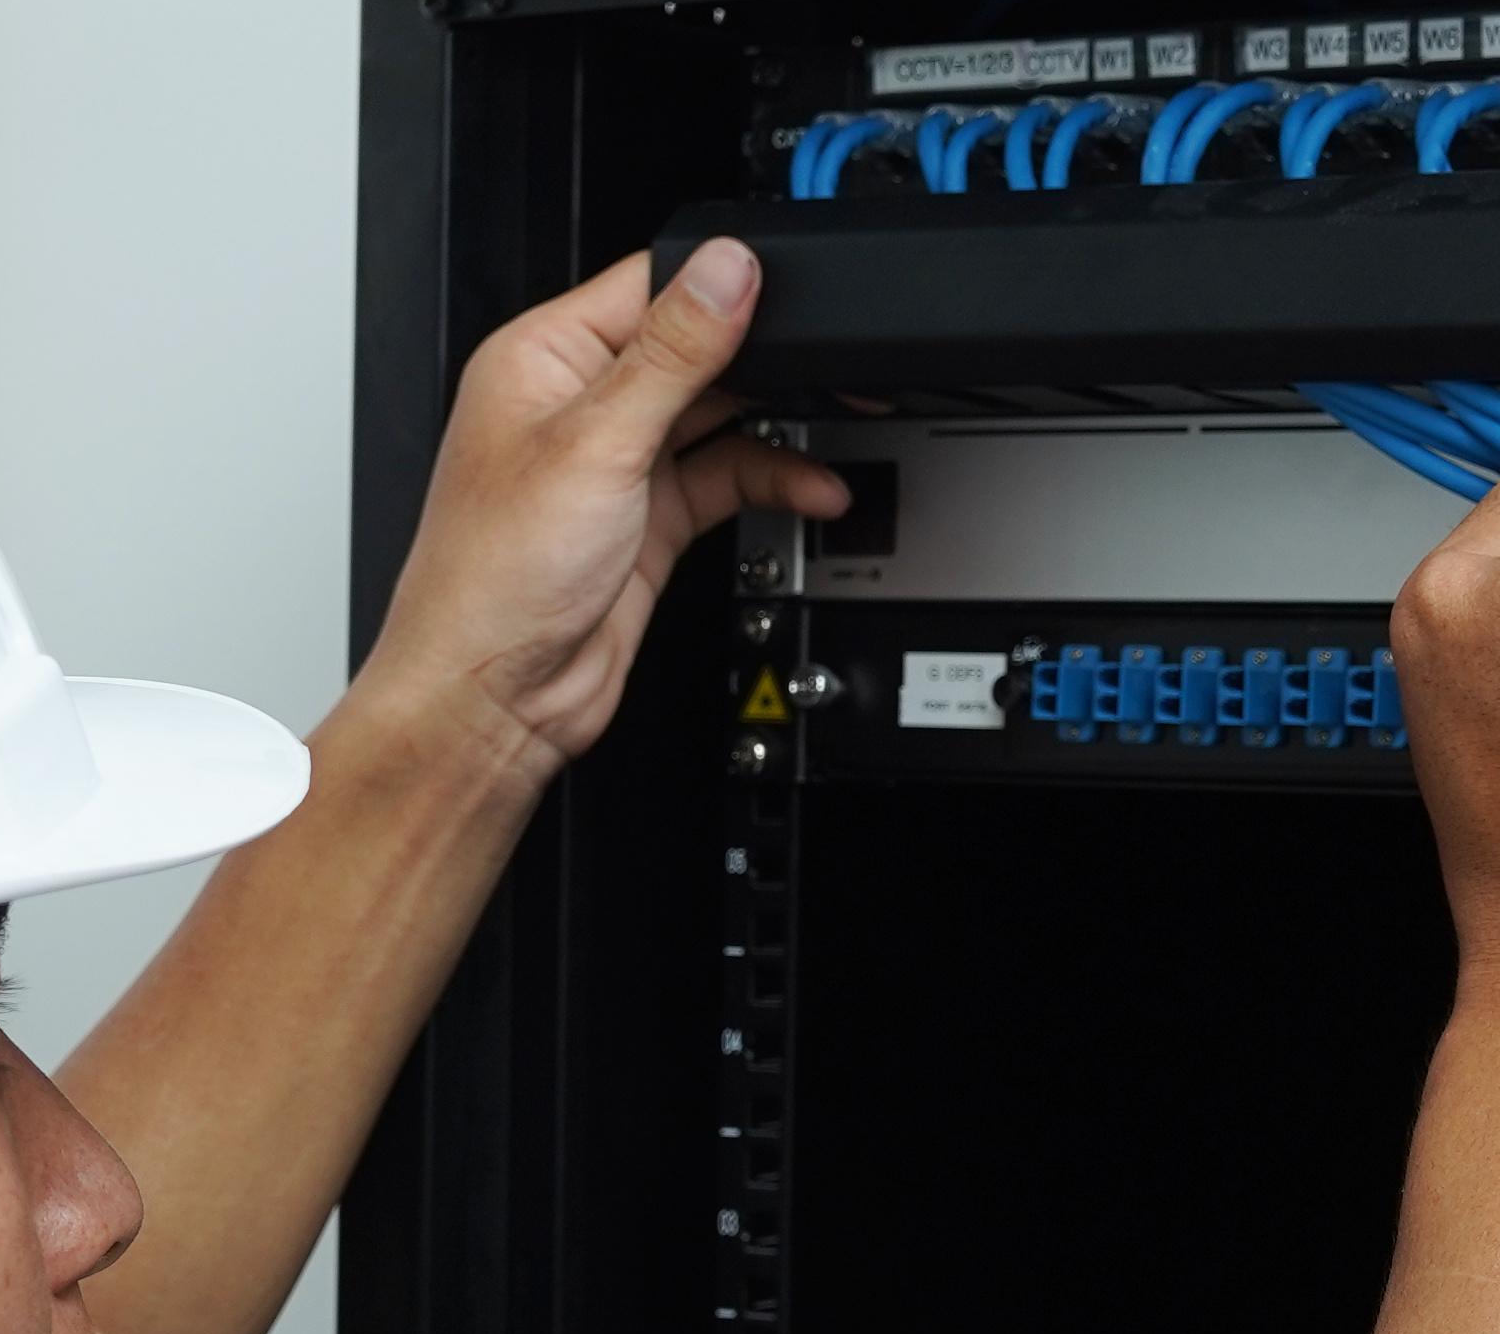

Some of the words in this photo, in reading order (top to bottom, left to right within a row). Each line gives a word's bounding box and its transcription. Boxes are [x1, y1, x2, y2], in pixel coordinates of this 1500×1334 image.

[1251, 34, 1285, 61] W3
[1310, 33, 1346, 58] W4
[1368, 28, 1406, 55] W5
[1422, 26, 1461, 51] W6
[1023, 43, 1088, 76] CCTV
[1100, 48, 1129, 70] W1
[1155, 43, 1187, 66] W2
